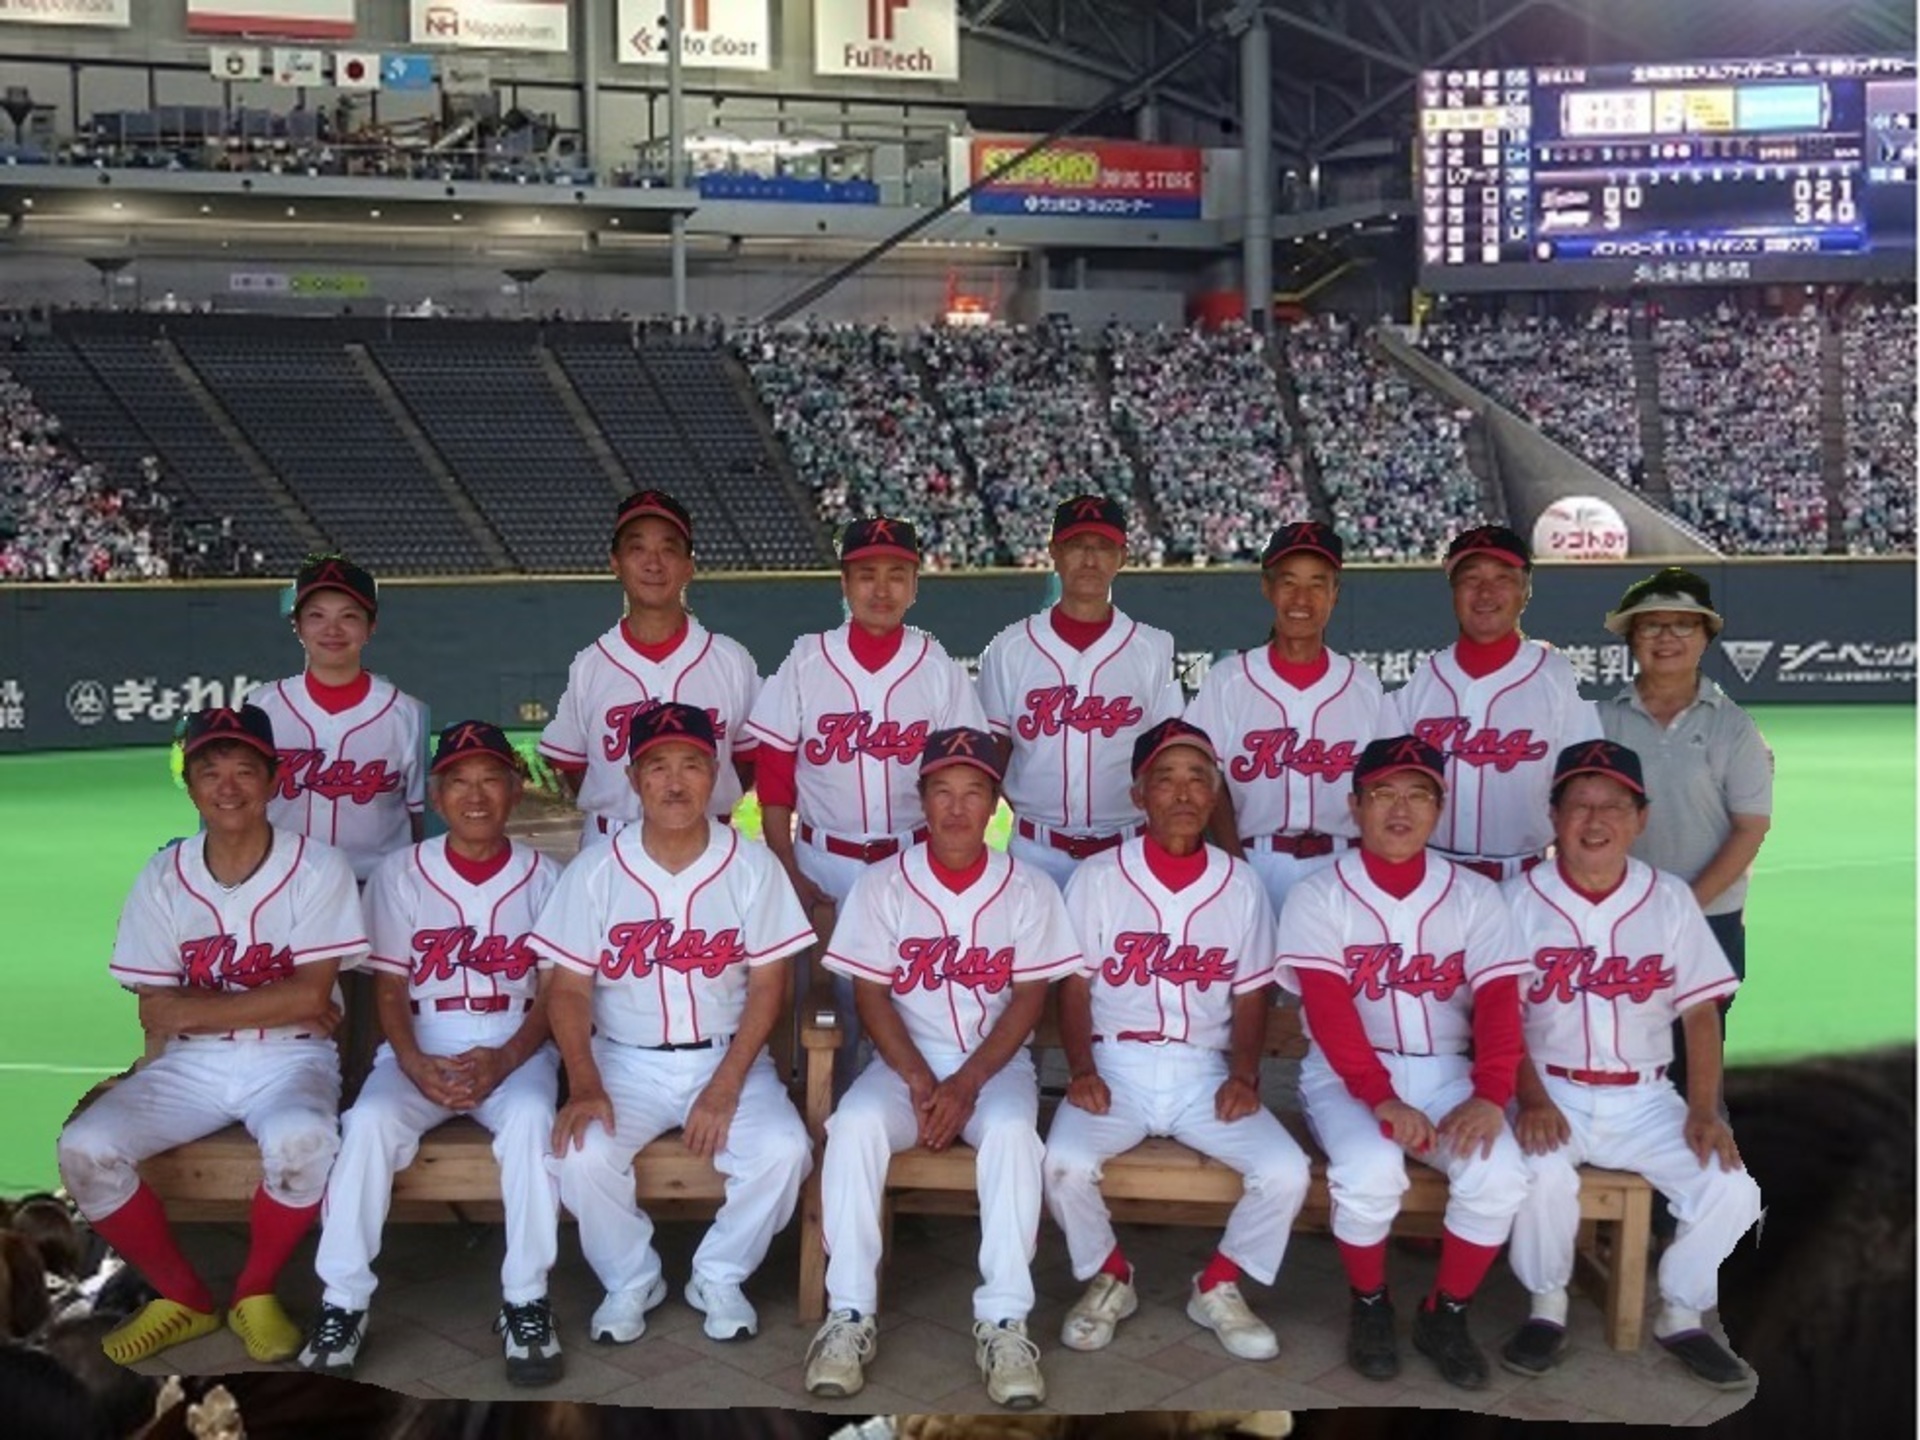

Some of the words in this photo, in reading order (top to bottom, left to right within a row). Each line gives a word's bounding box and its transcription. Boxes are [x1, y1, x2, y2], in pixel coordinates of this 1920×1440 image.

[710, 36, 758, 57] door
[843, 44, 933, 72] Fulltech
[865, 518, 895, 543] K
[449, 725, 485, 749] K
[804, 710, 930, 766] King
[1016, 684, 1143, 741] King
[942, 730, 979, 756] K
[1230, 727, 1363, 783] King
[1412, 716, 1548, 772] King
[272, 748, 401, 804] King
[411, 925, 540, 986] King
[601, 917, 744, 980] King
[894, 935, 1015, 994] King
[1102, 931, 1238, 991] King
[1344, 943, 1467, 1001] King
[1528, 946, 1676, 1004] King
